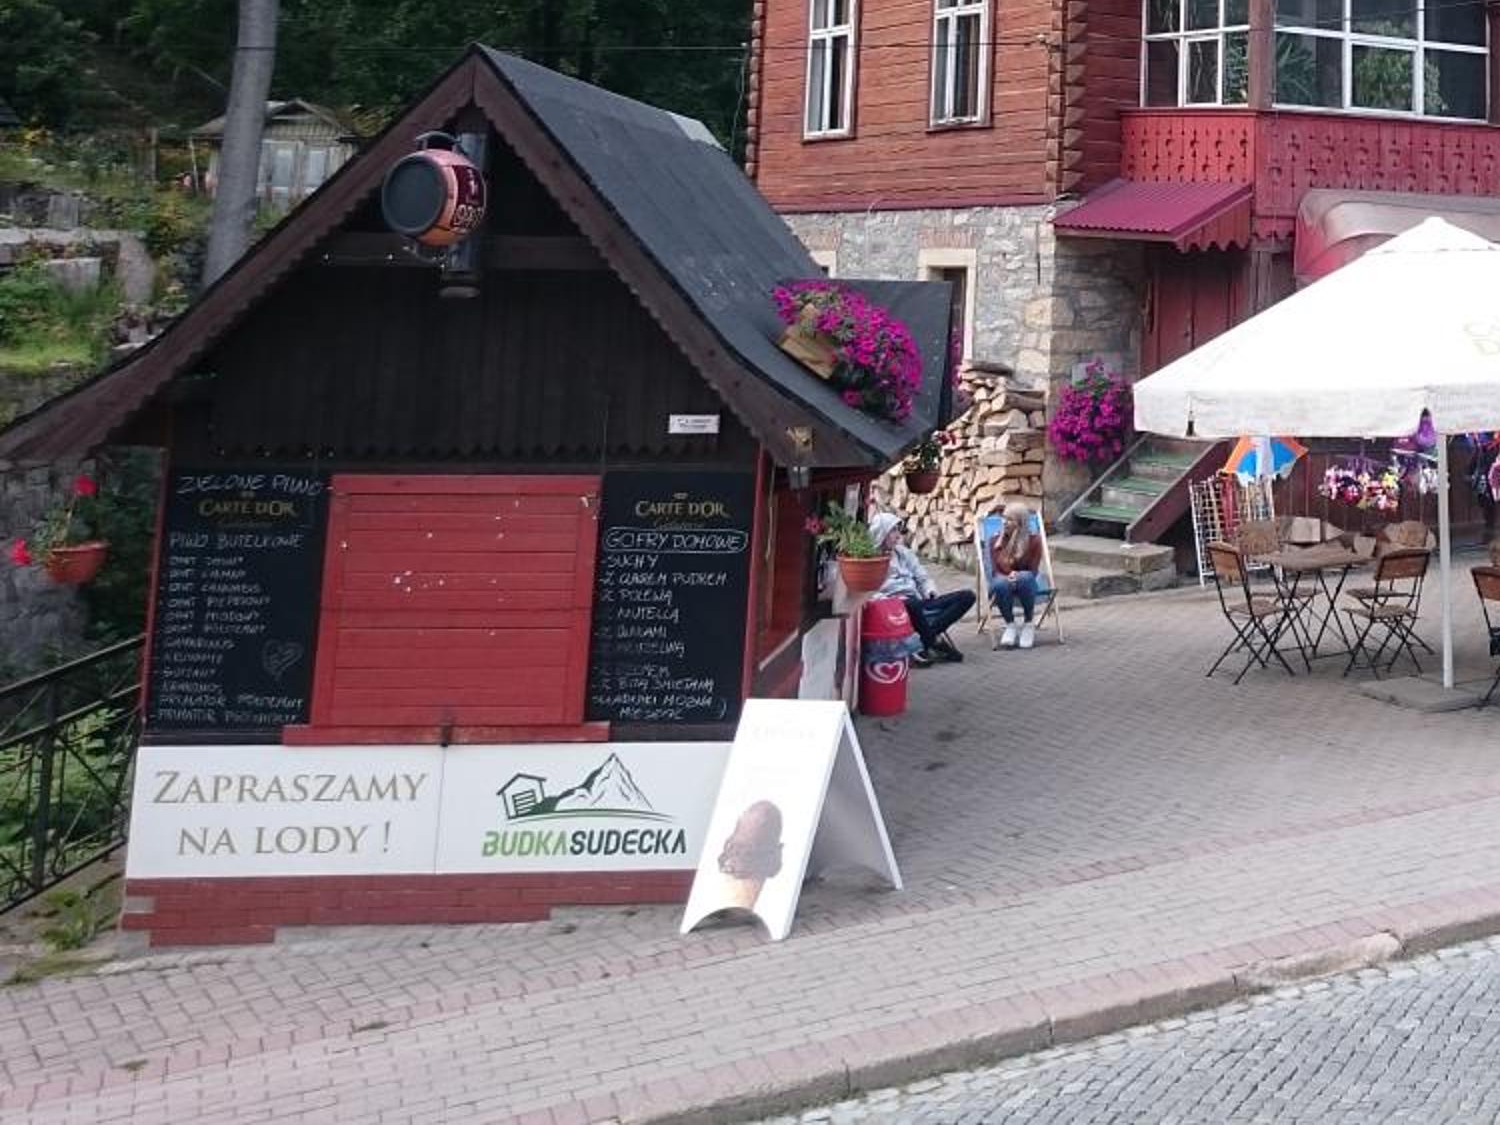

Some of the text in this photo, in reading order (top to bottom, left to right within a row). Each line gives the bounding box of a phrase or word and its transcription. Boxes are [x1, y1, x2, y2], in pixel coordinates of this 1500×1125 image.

[199, 498, 252, 517] CARTE
[635, 500, 732, 518] CARTE D'OR
[606, 532, 741, 550] GOFRY DOMOWE
[152, 770, 430, 804] ZAPRASZAMY
[177, 826, 238, 856] NA
[255, 825, 370, 855] LODY
[481, 828, 687, 857] BUDKASUDECKA
